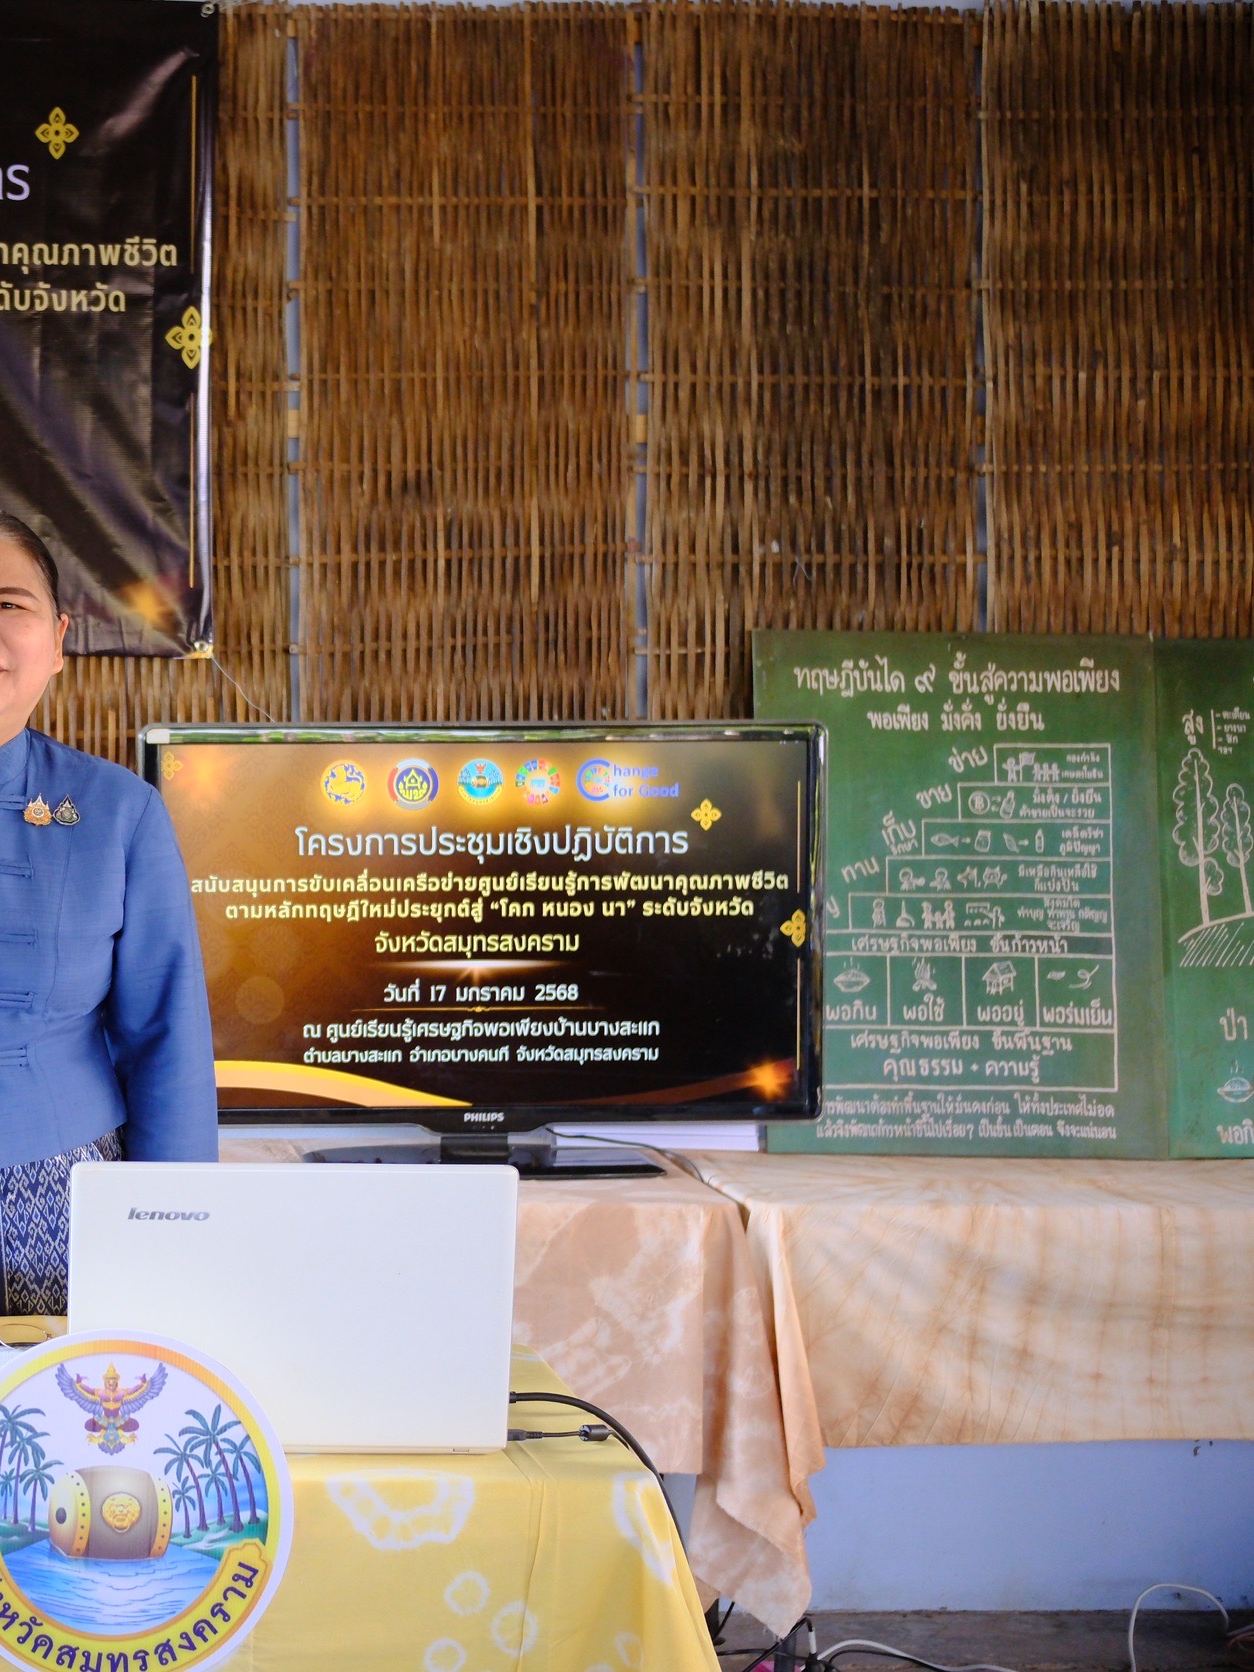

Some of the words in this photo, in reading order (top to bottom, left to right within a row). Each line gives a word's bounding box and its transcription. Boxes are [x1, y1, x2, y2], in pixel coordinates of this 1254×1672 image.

[914, 663, 936, 693] ๙
[948, 650, 1121, 706] ขั้นสู่ความพอเพียง
[867, 703, 929, 731] พอเพียง
[1182, 708, 1204, 745] สูง
[613, 784, 636, 798] for
[639, 783, 680, 798] Good
[916, 782, 953, 809] ขาย
[294, 823, 690, 863] โครงการประชุมเชิงปฏิบัติการ
[190, 868, 789, 898] สนับสนุนการขับเคลื่อนเครือข่ายศูนย์เรียนรู้การพัฒนาคุณภาพชีวิต
[841, 856, 880, 883] ทาน
[225, 898, 484, 924] ตามหลักทฤษฎีใหม่ประยุกต์สู่
[541, 900, 595, 918] หนอง
[642, 898, 754, 918] ระดับจังหวัด
[374, 930, 580, 958] จังหวัดสมุทรสงคราม
[383, 979, 421, 1005] วันที่
[430, 985, 447, 1003] 17
[455, 986, 525, 1003] มกราคม
[534, 983, 578, 1002] 2568
[902, 992, 945, 1022] พอใช้
[977, 999, 1025, 1026] พออยู่
[1042, 998, 1112, 1026] พอร่มเย็น
[303, 1022, 322, 1038] ณ
[326, 1017, 660, 1045] ศูนย์เรียนรู้เศรษฐกิจพอเพียงบ้านบางสะแก
[1219, 1007, 1248, 1041] ป่า
[303, 1046, 402, 1065] ตำบลบางสะแก
[409, 1045, 509, 1064] อำเภอบางคนที
[516, 1044, 659, 1066] จังหวัดสมุทรสงคราม
[883, 1058, 963, 1081] คุณธรรม
[985, 1054, 1040, 1083] ความรู้
[464, 1112, 504, 1123] PHILIPS
[127, 1207, 211, 1223] lenovo
